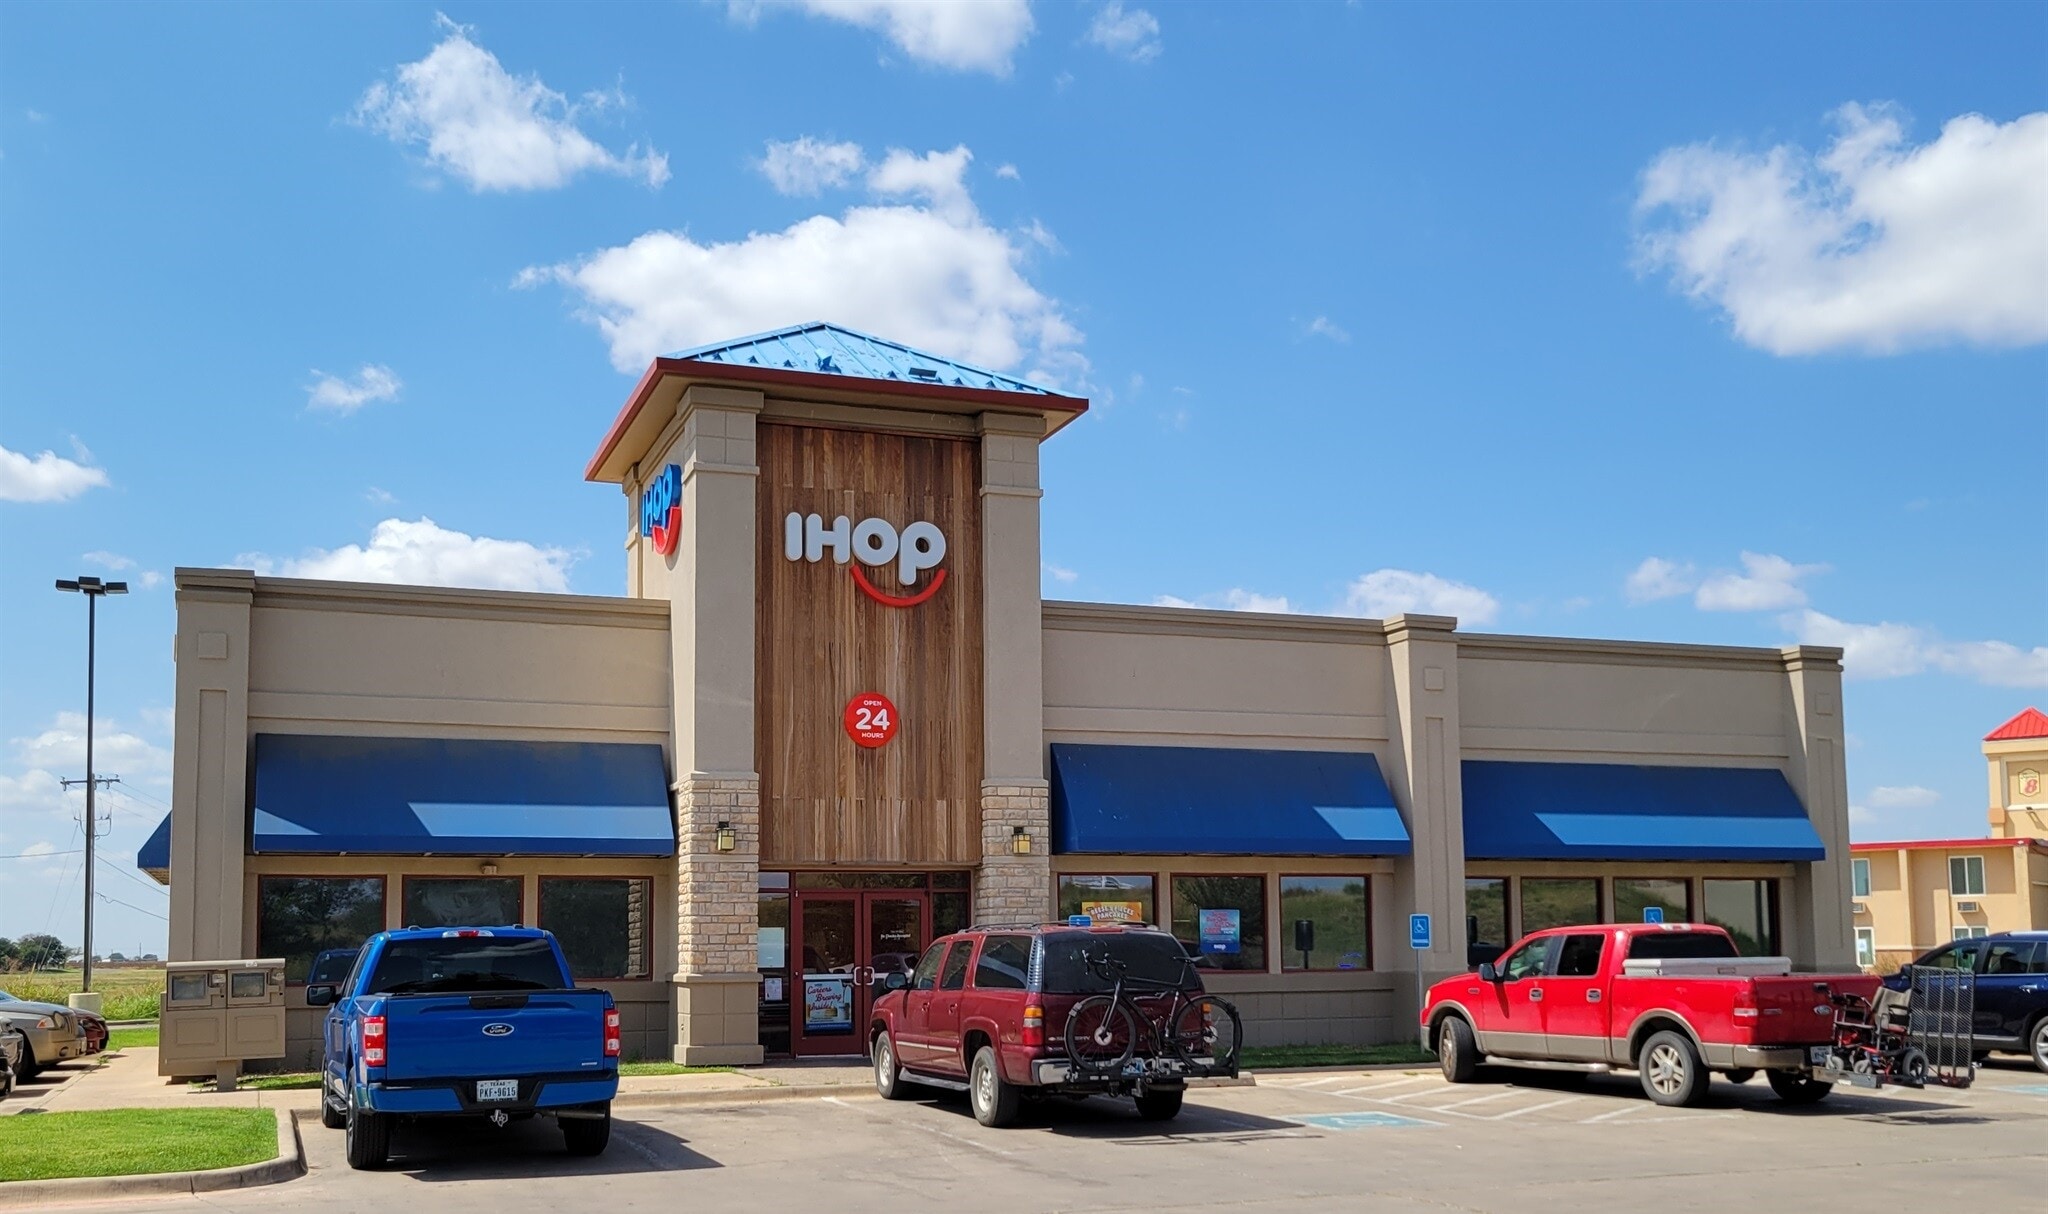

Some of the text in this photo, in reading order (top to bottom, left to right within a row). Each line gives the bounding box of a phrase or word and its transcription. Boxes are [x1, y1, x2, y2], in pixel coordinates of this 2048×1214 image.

[785, 511, 947, 585] IHOP
[855, 707, 890, 730] 24
[2025, 778, 2038, 794] 8
[489, 1025, 507, 1034] Ford
